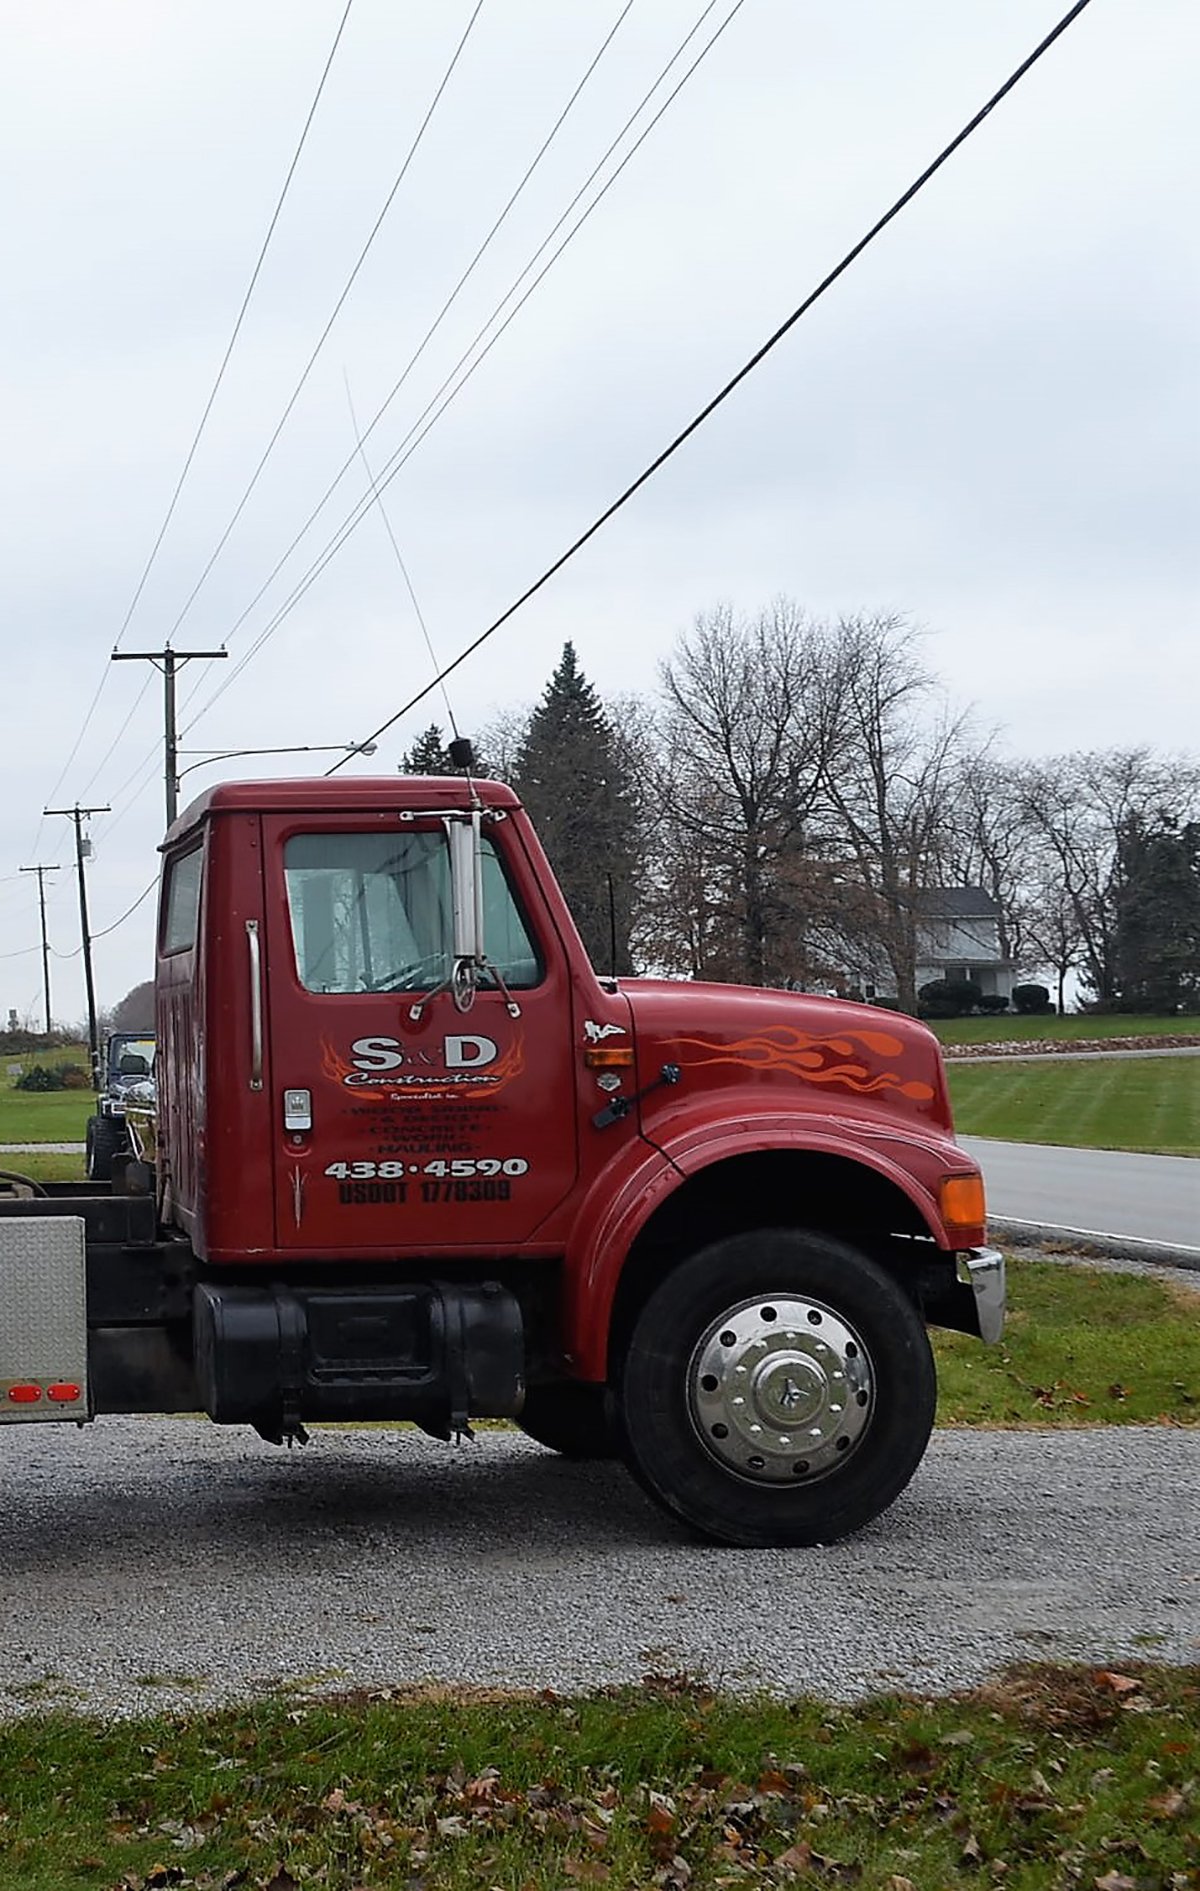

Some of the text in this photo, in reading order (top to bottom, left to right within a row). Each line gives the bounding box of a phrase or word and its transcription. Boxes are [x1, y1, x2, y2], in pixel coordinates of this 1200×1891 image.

[351, 1036, 403, 1071] S
[444, 1034, 498, 1068] D
[343, 1073, 500, 1086] Construction
[377, 1143, 473, 1154] HAULING
[340, 1183, 406, 1203] USDOT
